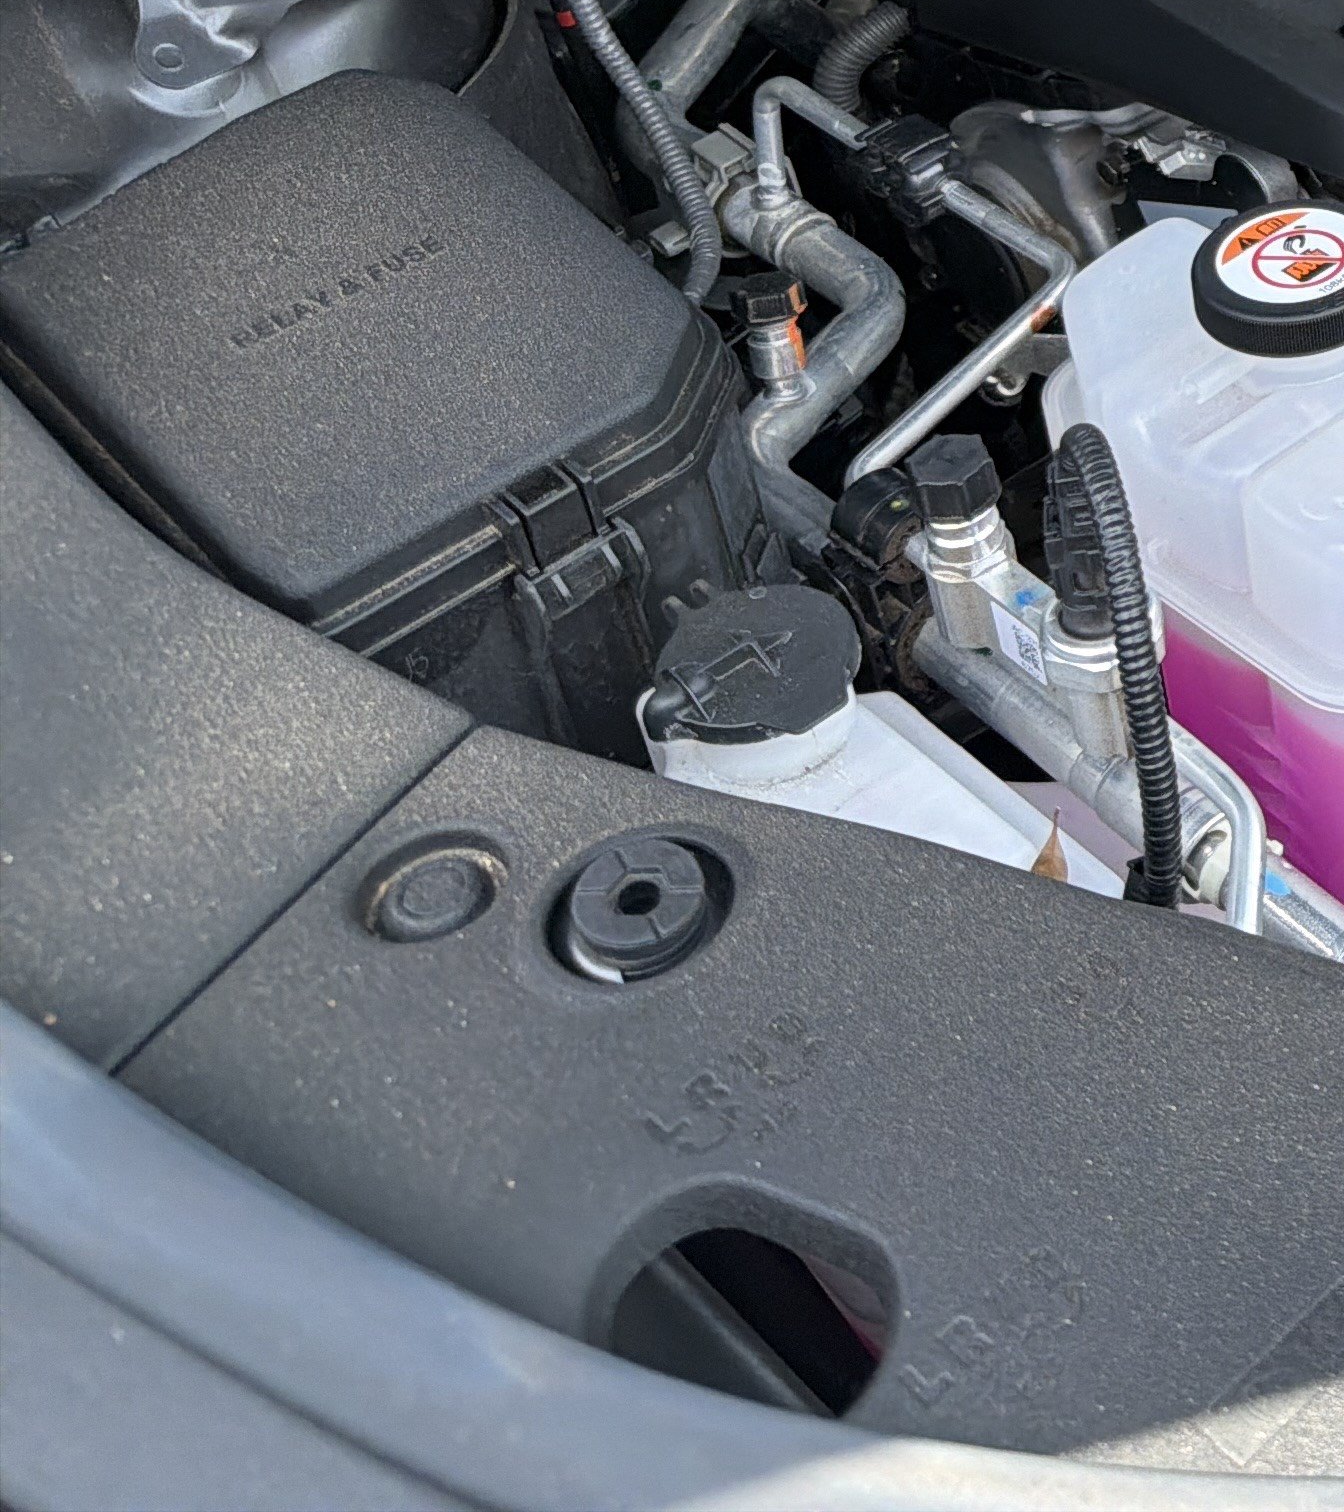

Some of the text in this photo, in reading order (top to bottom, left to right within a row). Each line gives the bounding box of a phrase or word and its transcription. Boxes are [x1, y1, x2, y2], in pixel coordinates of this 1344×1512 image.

[230, 234, 443, 348] RELAY & FUSE
